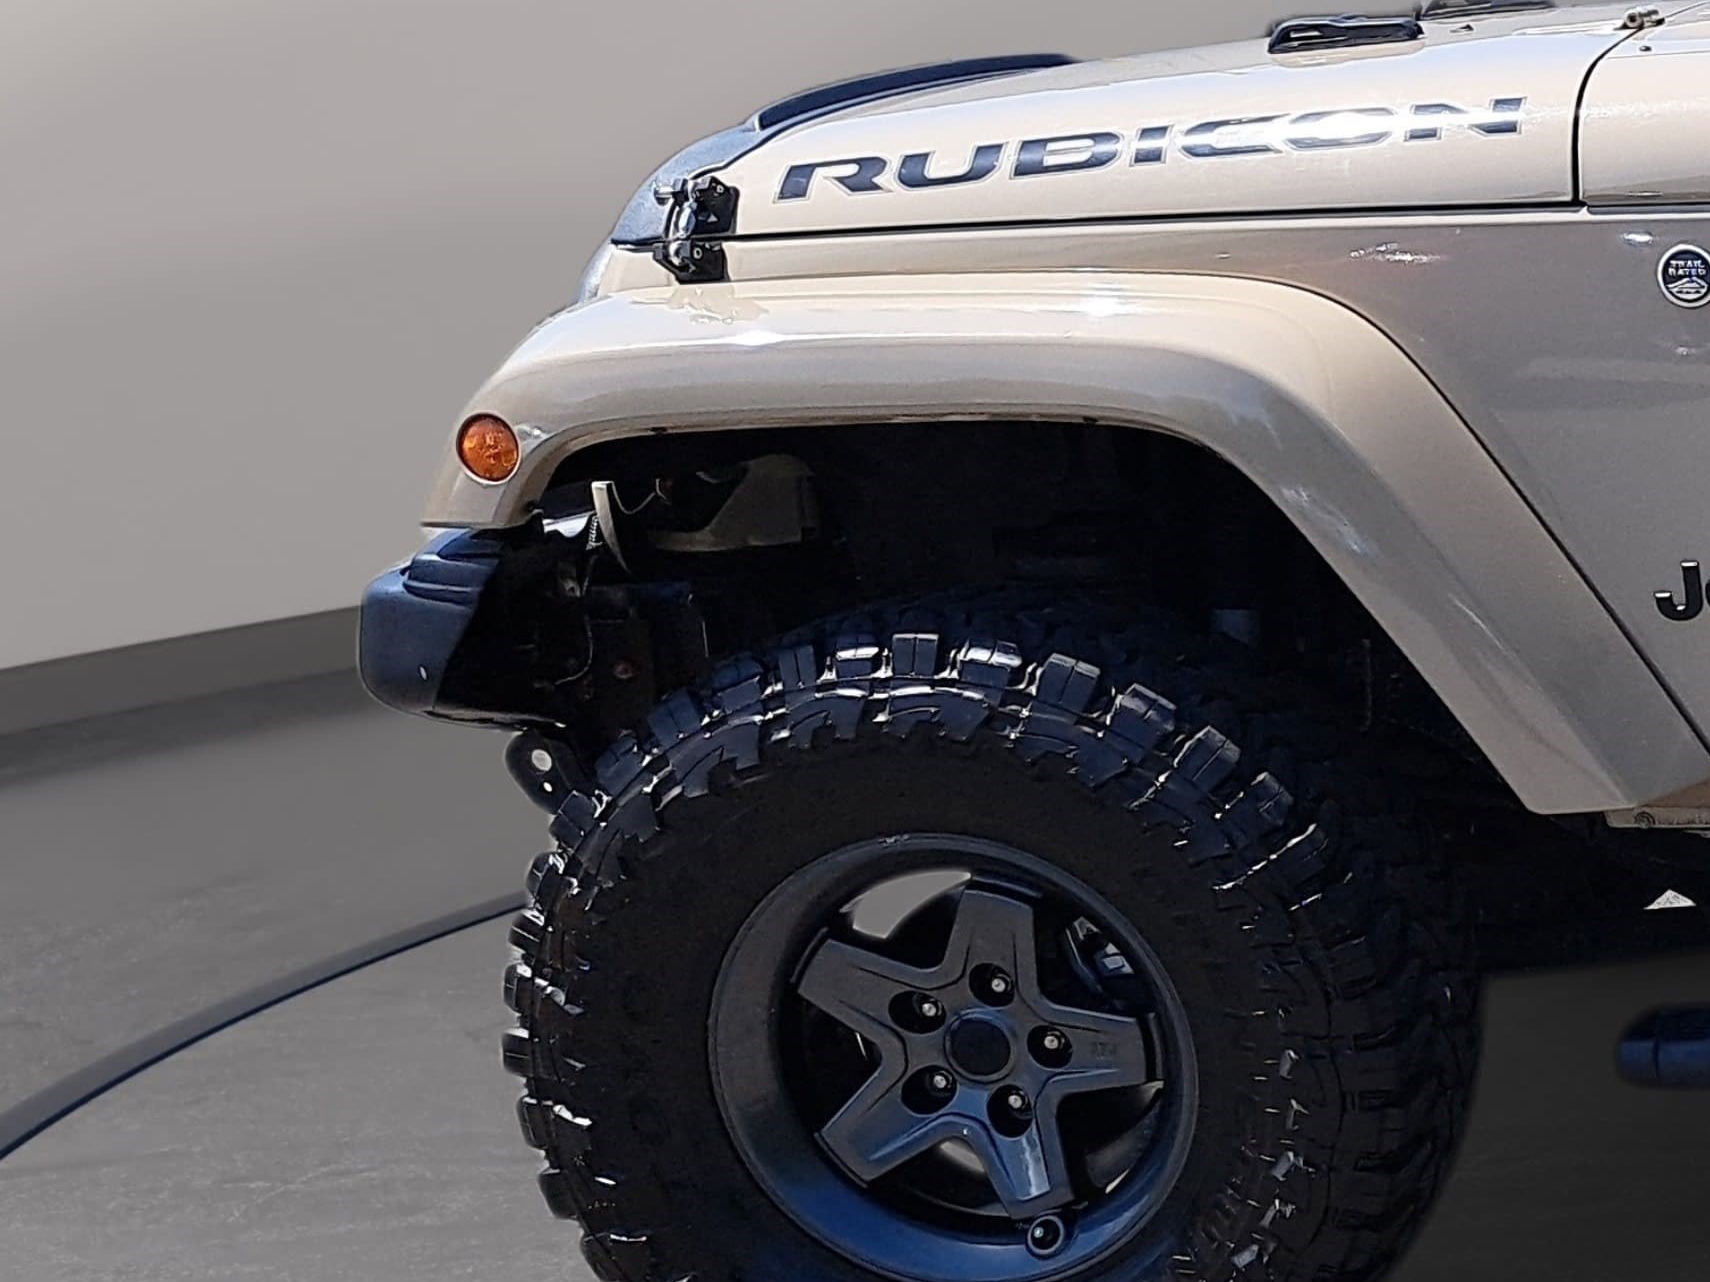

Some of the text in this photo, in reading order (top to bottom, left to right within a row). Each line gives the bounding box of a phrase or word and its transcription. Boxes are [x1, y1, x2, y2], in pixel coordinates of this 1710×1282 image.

[772, 94, 1528, 205] RUBICON
[1670, 260, 1705, 268] TRAIL
[1668, 268, 1707, 276] RATED
